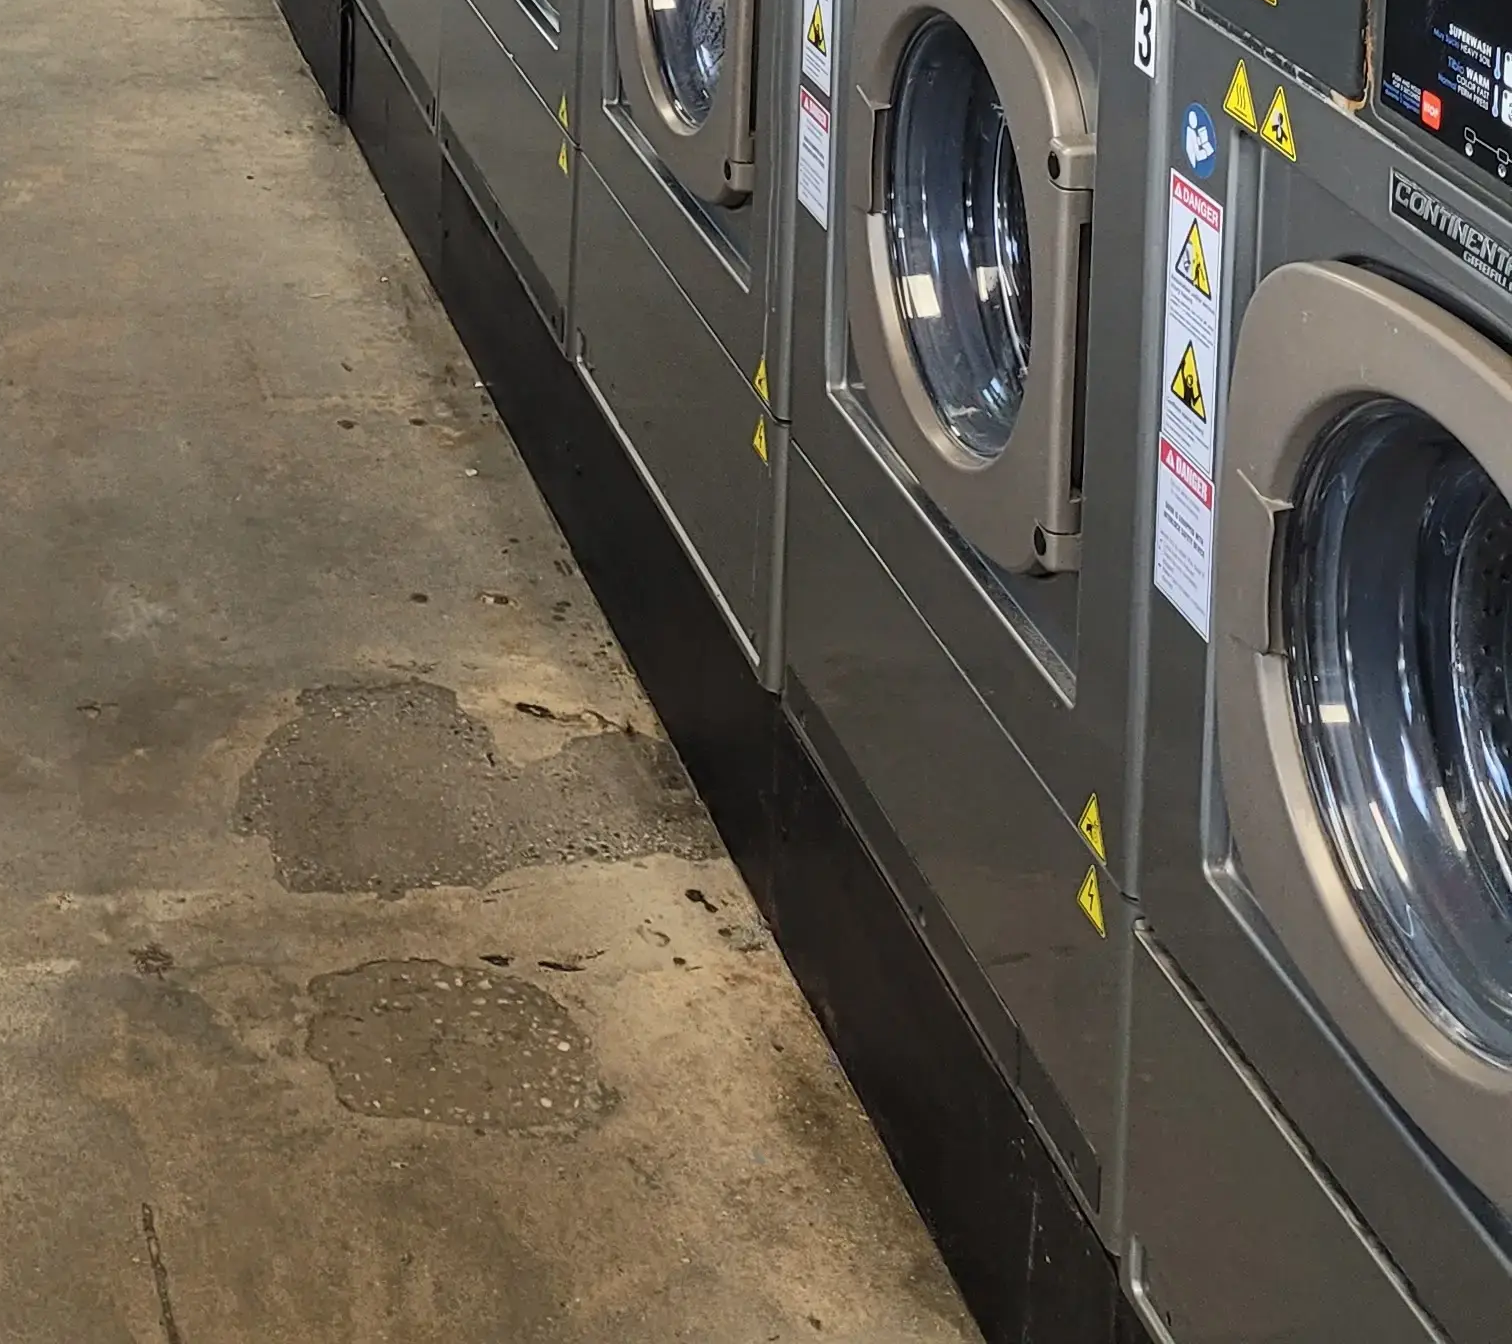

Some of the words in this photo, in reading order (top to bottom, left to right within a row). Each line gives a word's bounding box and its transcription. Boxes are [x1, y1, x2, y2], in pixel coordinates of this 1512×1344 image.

[1449, 23, 1492, 58] SUPERWASH
[1460, 41, 1478, 59] HEAVY
[1456, 73, 1476, 92] COLOR
[1477, 85, 1490, 100] FAST
[1466, 66, 1490, 90] WARM
[1457, 86, 1473, 101] PERM
[1473, 94, 1489, 111] PRESS
[1182, 186, 1219, 228] DANGER
[1175, 455, 1208, 502] DANGER
